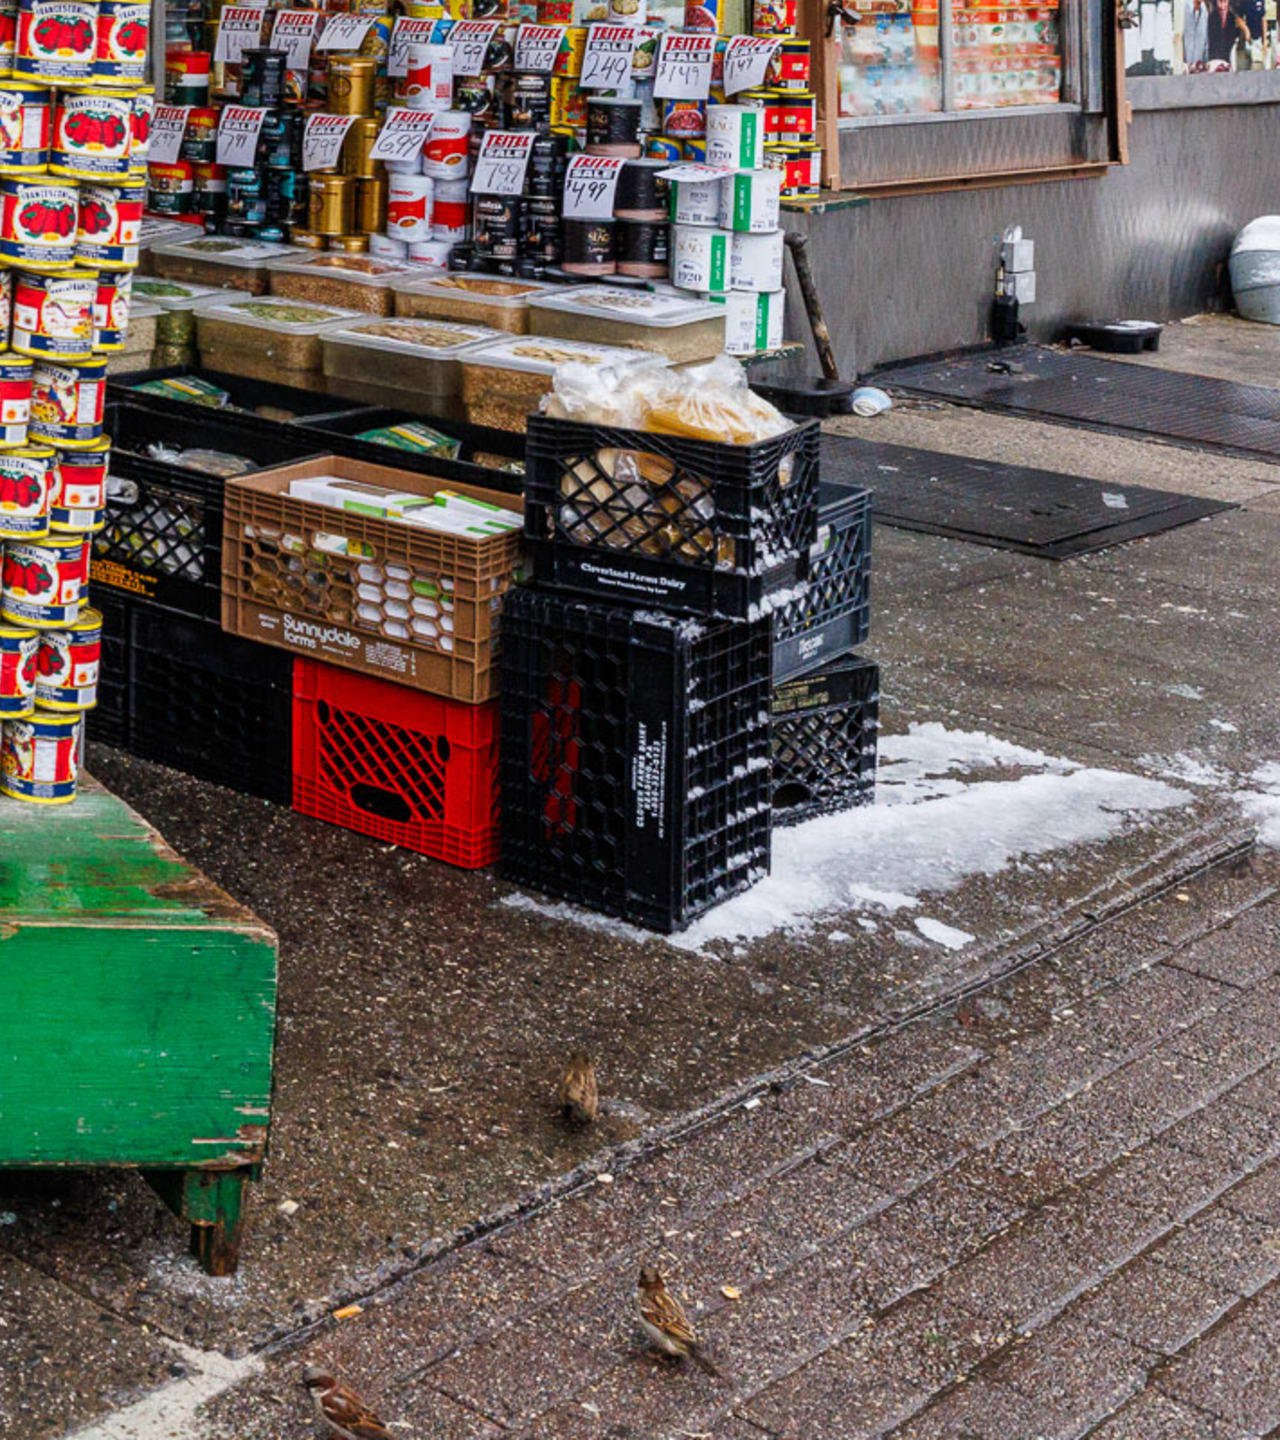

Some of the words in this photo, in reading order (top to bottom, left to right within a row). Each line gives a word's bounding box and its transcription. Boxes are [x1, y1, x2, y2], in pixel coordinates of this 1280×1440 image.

[224, 8, 261, 21] TEITEL
[278, 13, 315, 26] TEITEL
[222, 21, 259, 31] SALE
[275, 26, 311, 36] SALE
[397, 20, 433, 33] TEITEL
[454, 21, 495, 33] TEITEL
[396, 33, 429, 43] SALE
[451, 33, 488, 42] SALE
[521, 26, 562, 39] TEITEL
[592, 26, 635, 40] TEITEL
[518, 41, 557, 51] SALE
[589, 41, 633, 52] SALE
[666, 36, 713, 50] TEITEL
[663, 52, 710, 63] SALE
[153, 106, 188, 120] TEITEL
[225, 107, 262, 120] TEITEL
[392, 111, 435, 122] TEITEL
[151, 120, 182, 131] SALE
[222, 121, 259, 132] SALE
[309, 116, 350, 128] TEITEL
[307, 126, 346, 137] SALE
[486, 134, 530, 148] TEITEL
[484, 148, 528, 159] SALE
[572, 157, 621, 169] TEITEL
[283, 613, 361, 650] Sunnydale
[283, 632, 317, 649] farms
